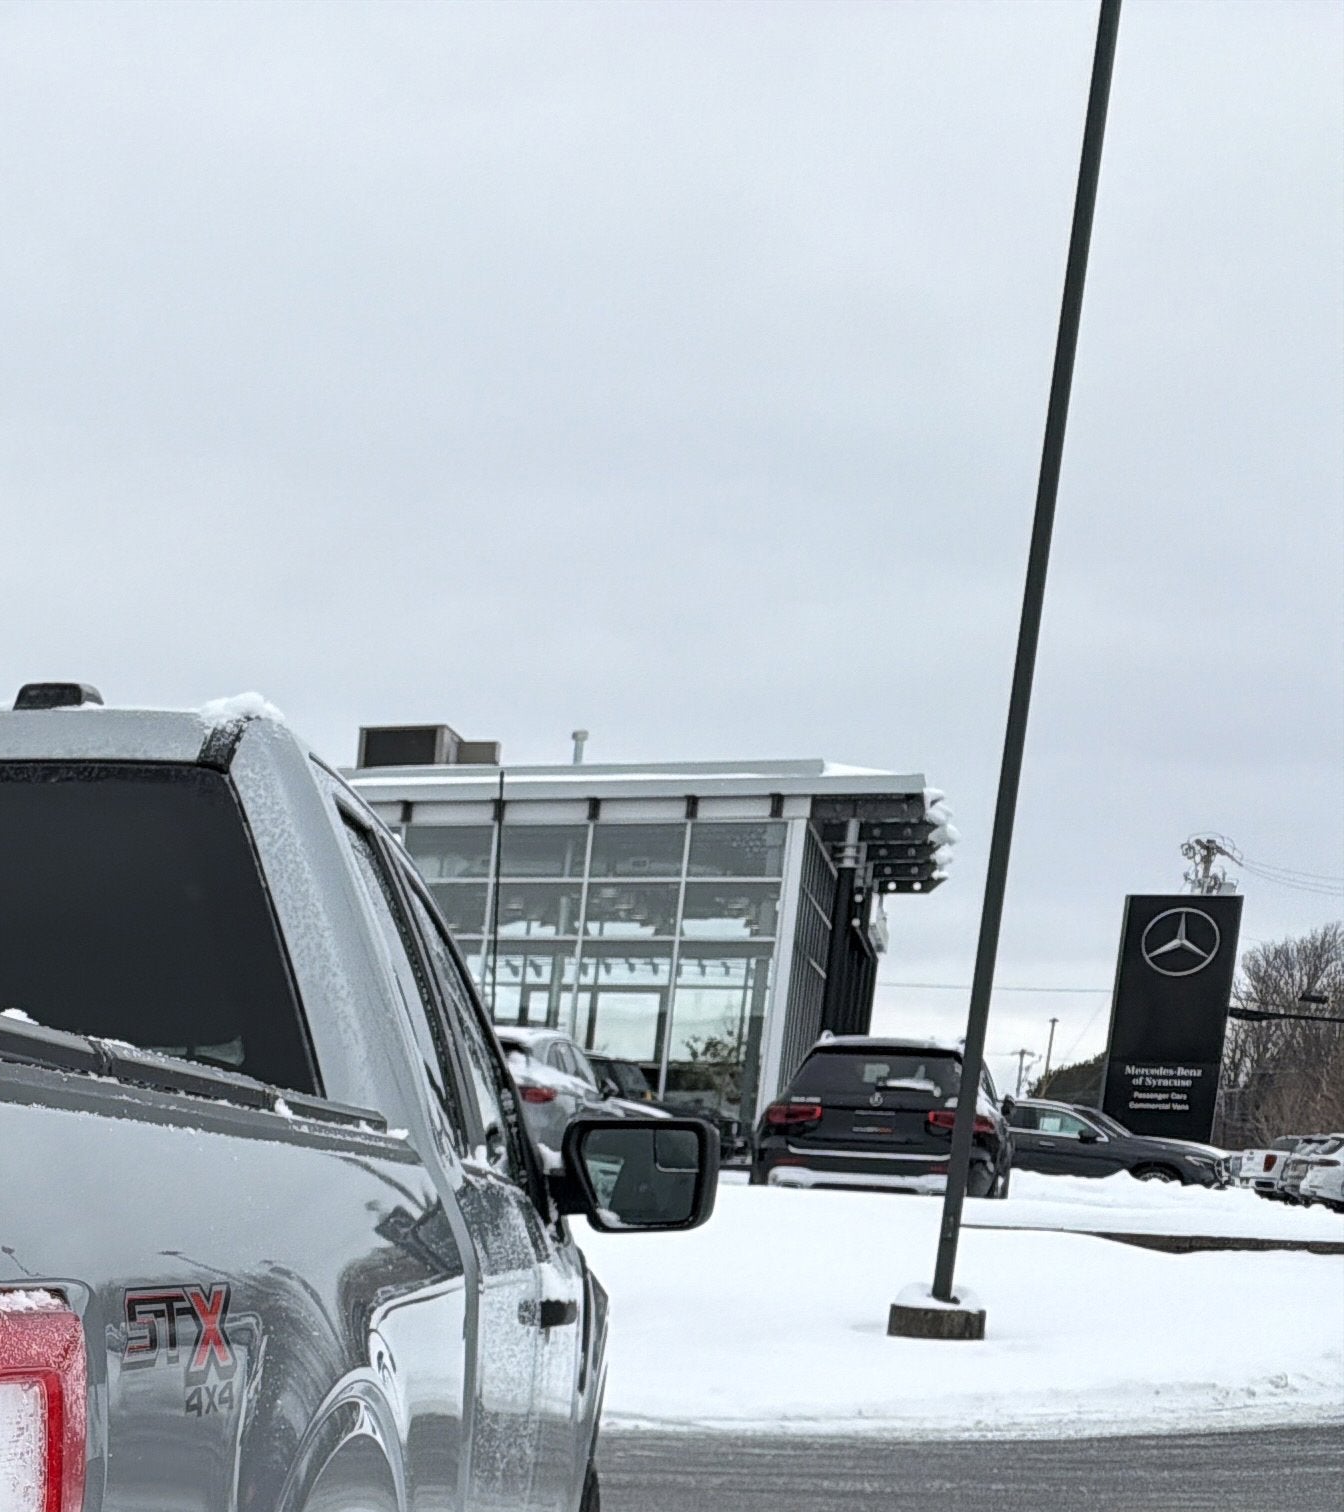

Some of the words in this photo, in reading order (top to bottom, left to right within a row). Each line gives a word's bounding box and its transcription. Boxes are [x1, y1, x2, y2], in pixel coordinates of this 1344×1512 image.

[1124, 1064, 1203, 1077] Mercedes-Benz
[1132, 1076, 1144, 1086] of
[1144, 1076, 1193, 1088] Syracuse
[1133, 1091, 1169, 1101] Passenger
[1128, 1101, 1171, 1110] Commercial
[120, 1282, 237, 1382] STX
